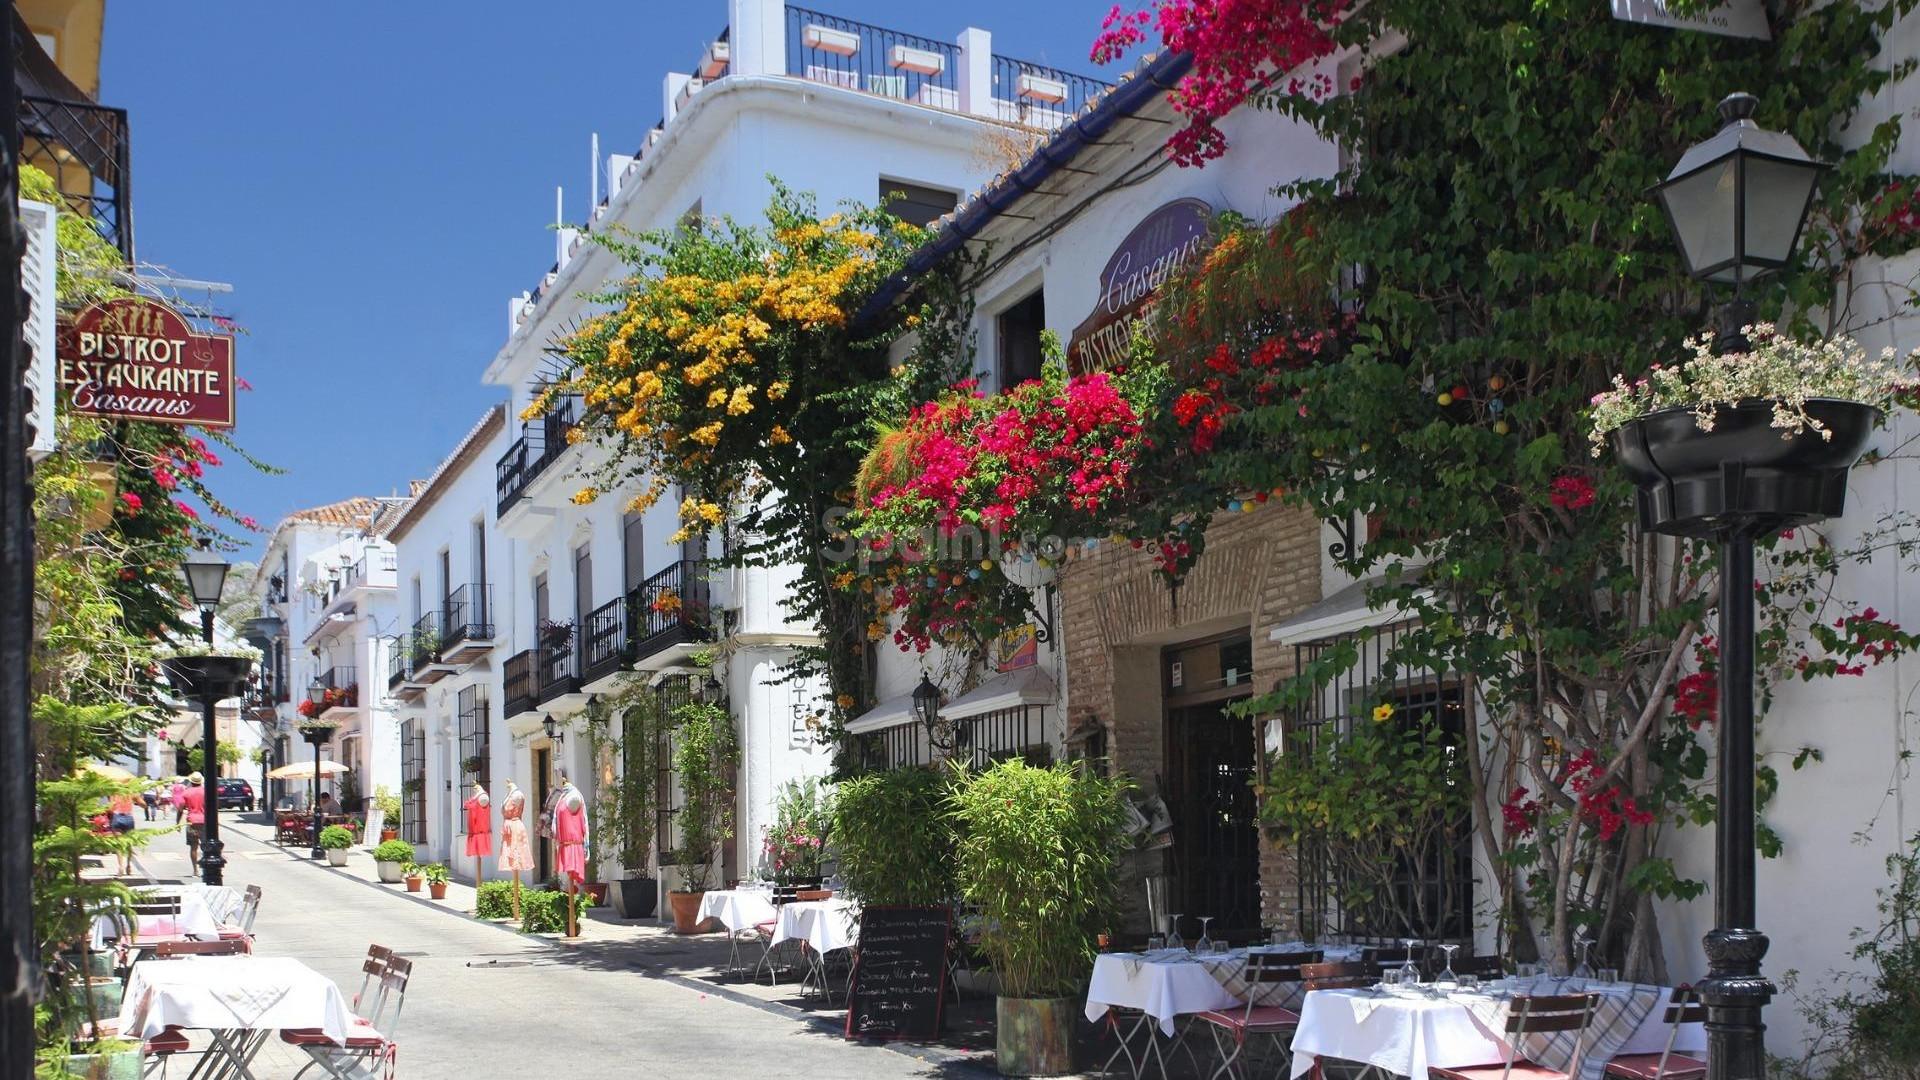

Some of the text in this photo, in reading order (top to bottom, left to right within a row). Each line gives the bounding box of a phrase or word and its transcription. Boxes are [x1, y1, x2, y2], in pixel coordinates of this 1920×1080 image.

[1107, 225, 1200, 315] Casanis
[80, 331, 186, 365] BISTROT
[56, 358, 221, 396] ESTAURANTE
[72, 380, 197, 416] Casanis
[792, 674, 807, 732] OTEL
